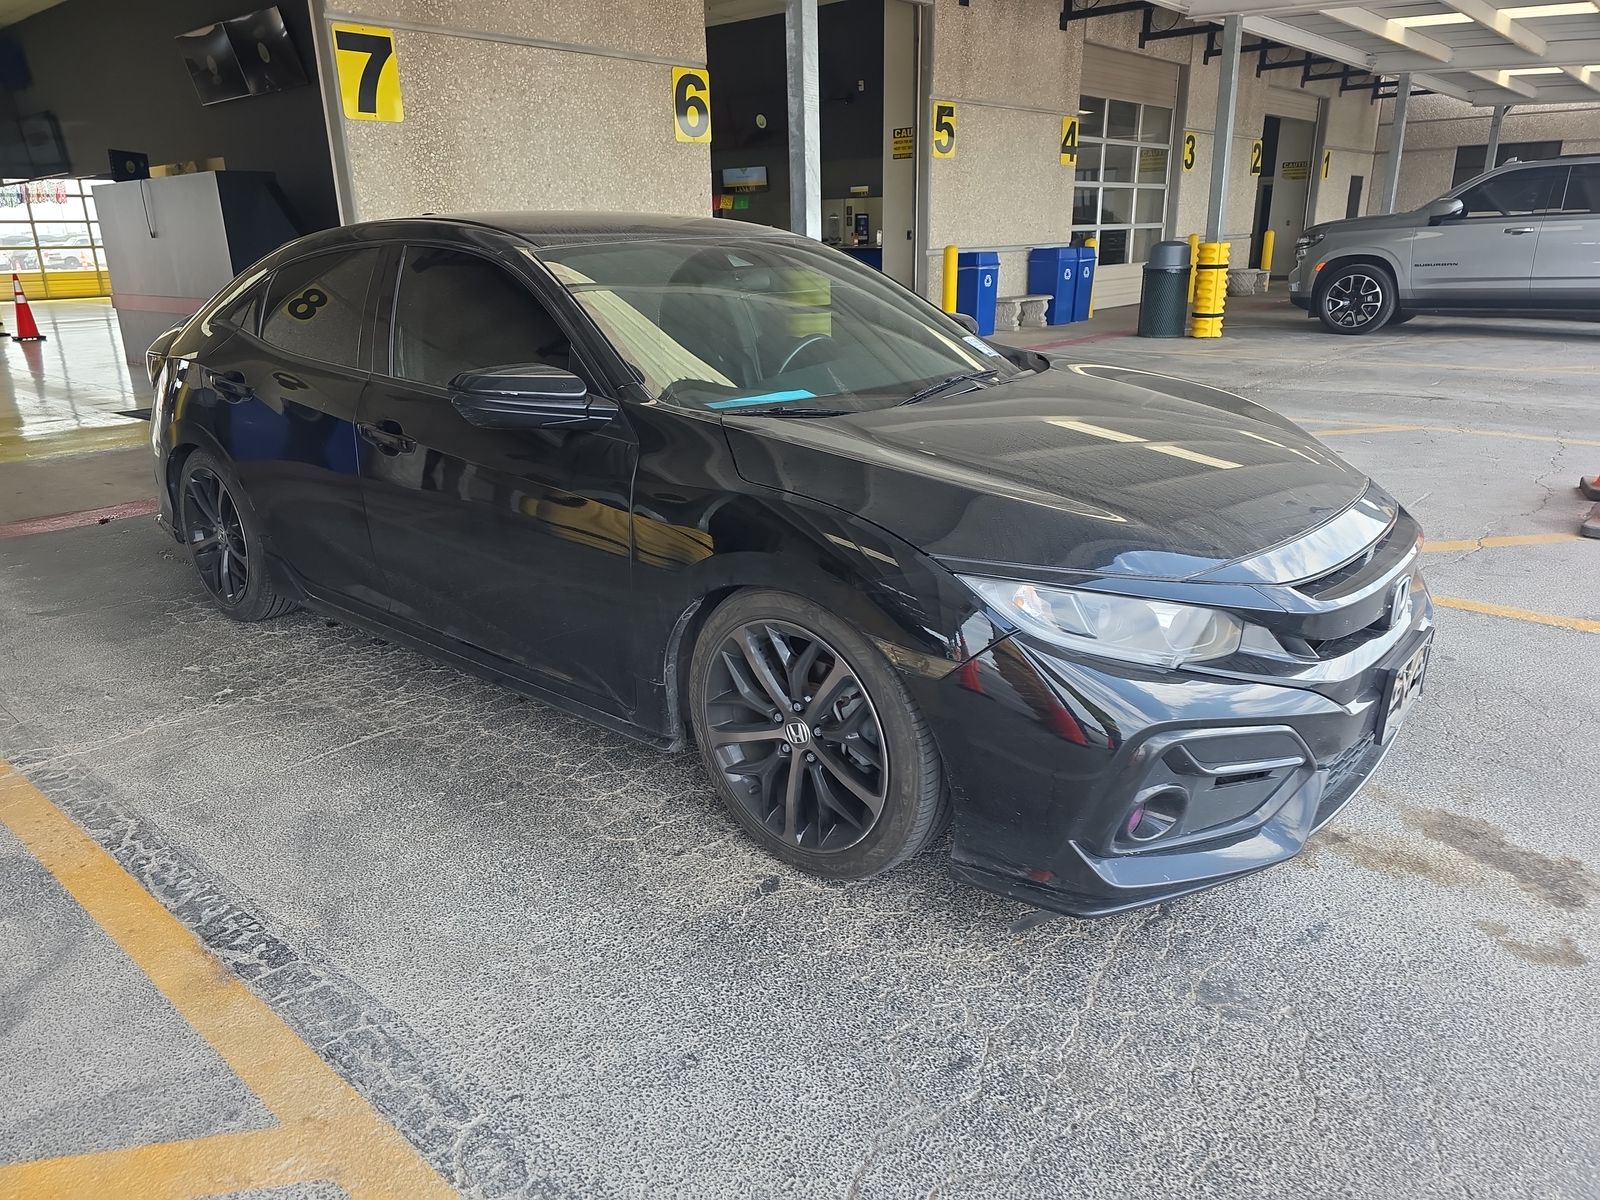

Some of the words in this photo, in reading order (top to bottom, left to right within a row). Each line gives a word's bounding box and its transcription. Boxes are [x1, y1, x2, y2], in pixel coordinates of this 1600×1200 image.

[335, 30, 393, 114] 7
[675, 73, 709, 138] 6
[934, 105, 955, 154] 5
[1061, 121, 1078, 162] 4
[1184, 134, 1196, 170] 3
[1252, 142, 1262, 174] 2
[1324, 151, 1331, 179] 1
